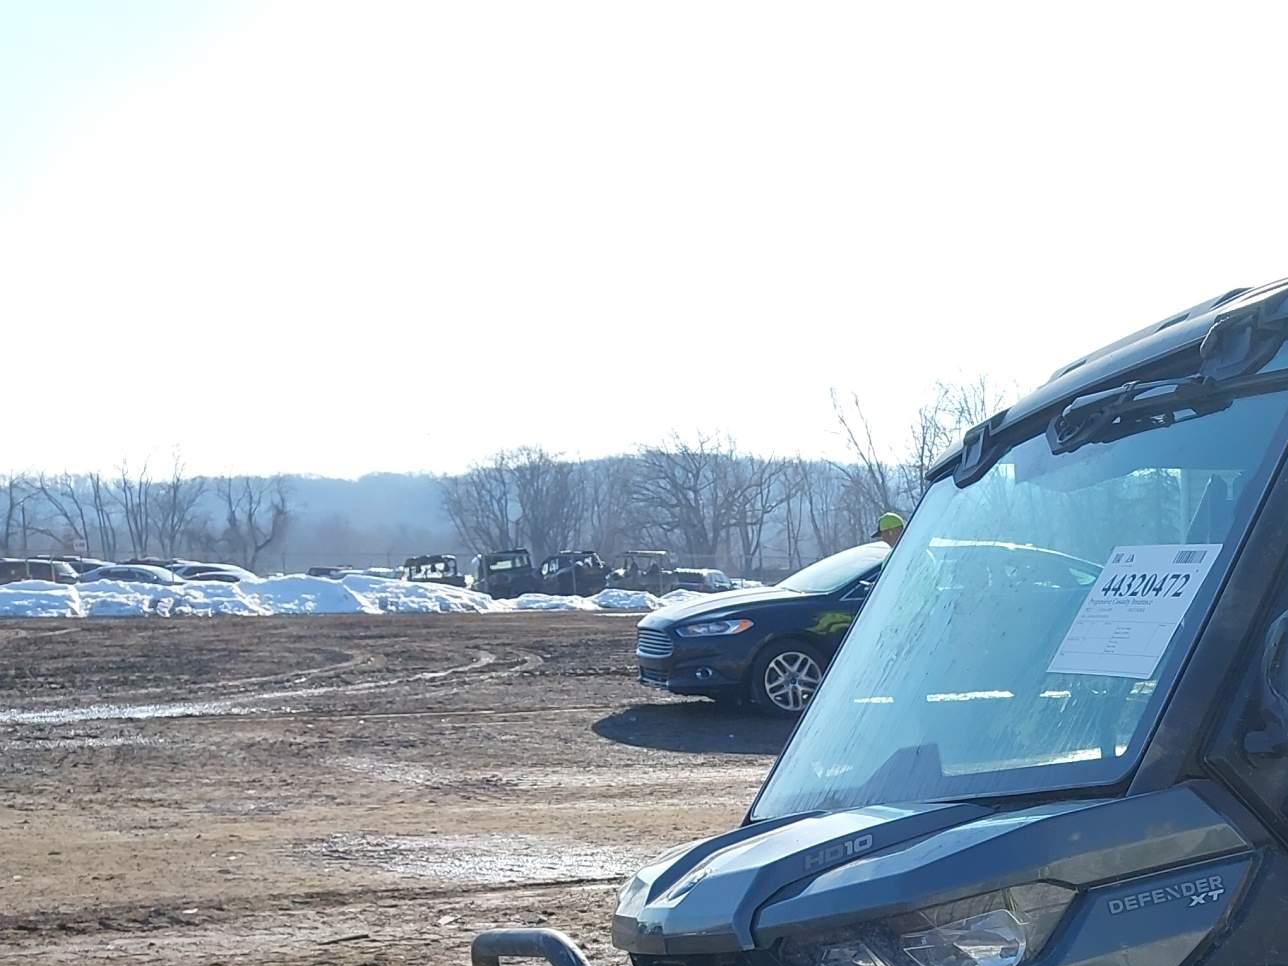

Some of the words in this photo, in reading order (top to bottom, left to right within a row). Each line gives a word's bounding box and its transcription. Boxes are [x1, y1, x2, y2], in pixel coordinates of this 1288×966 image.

[1102, 573, 1190, 597] 44320472
[804, 834, 873, 870] HD10
[1108, 875, 1224, 914] DEFENDER
[1189, 888, 1225, 906] XT
